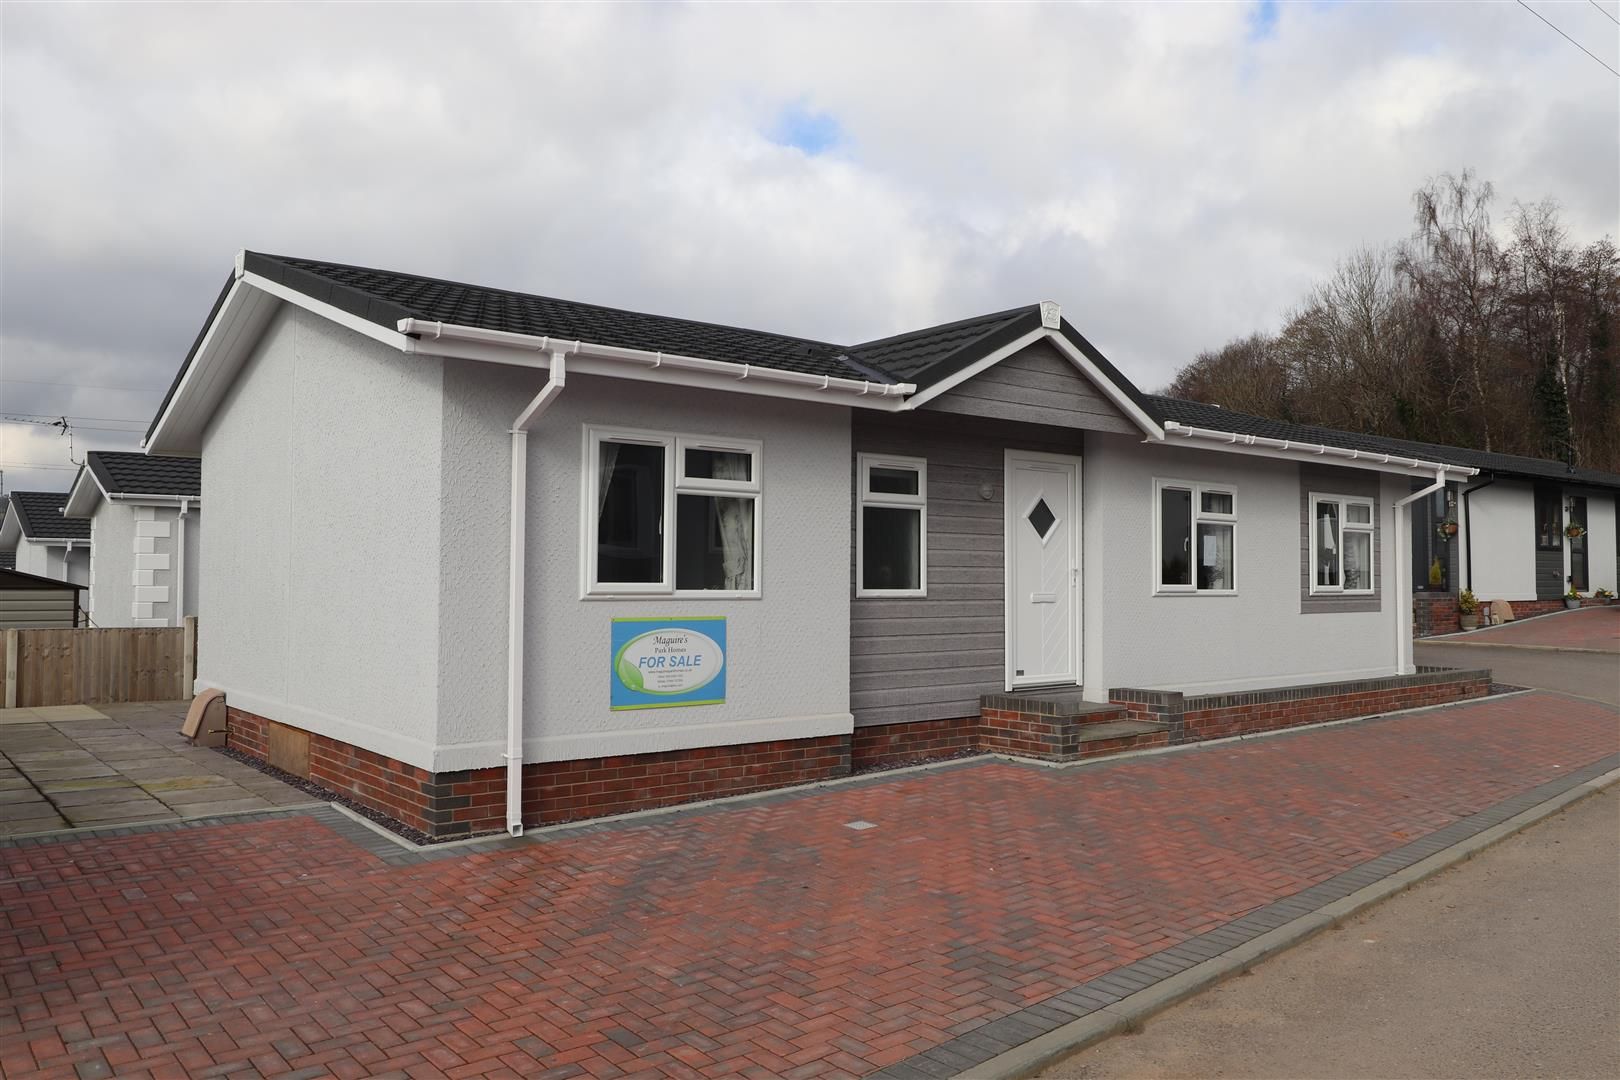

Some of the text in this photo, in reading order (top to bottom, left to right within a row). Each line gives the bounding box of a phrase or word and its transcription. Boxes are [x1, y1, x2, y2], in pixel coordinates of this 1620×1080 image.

[653, 635, 688, 646] Maguire's
[639, 655, 702, 668] FOR SALE
